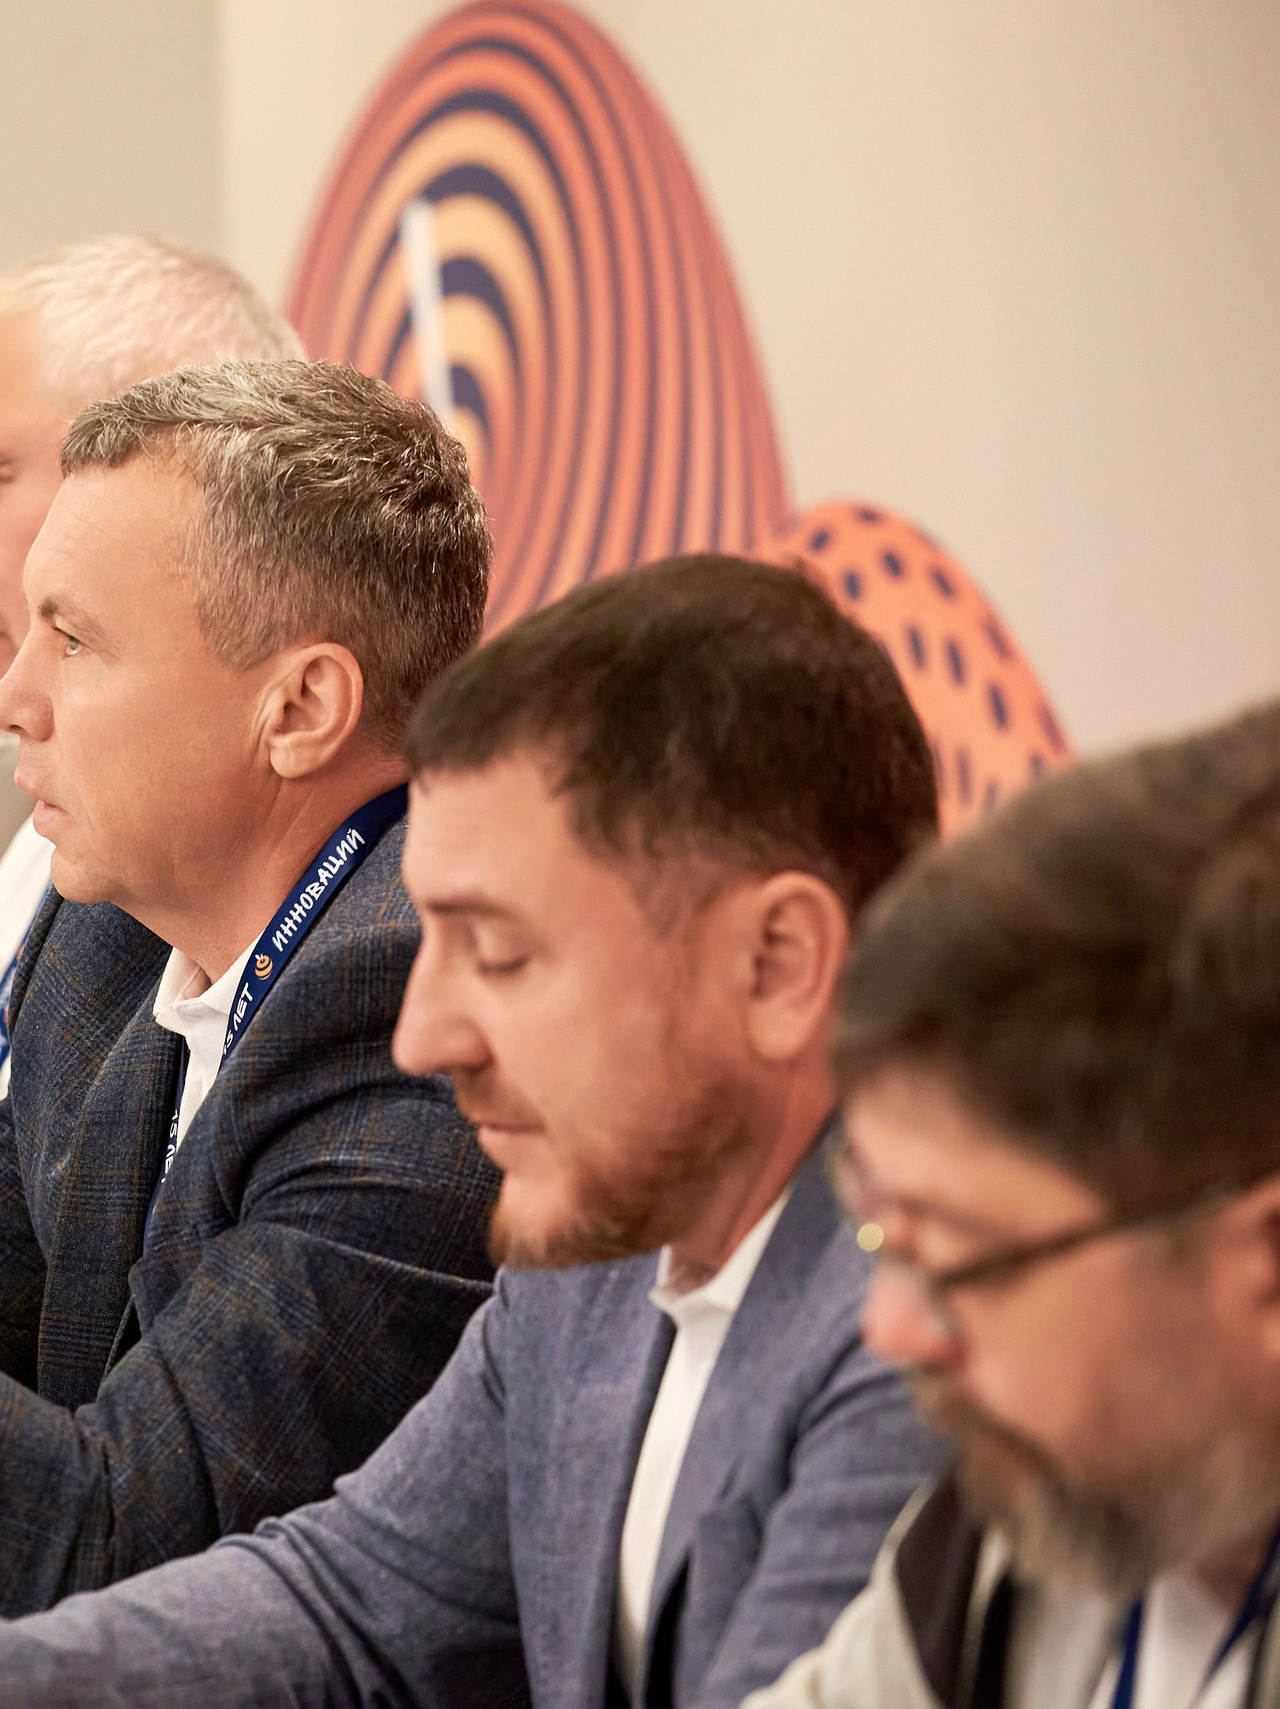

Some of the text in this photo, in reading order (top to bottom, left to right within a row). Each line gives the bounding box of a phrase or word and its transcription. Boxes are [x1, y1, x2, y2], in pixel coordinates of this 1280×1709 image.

[233, 981, 253, 1031] ЛЕТ
[271, 828, 365, 952] ИННОВАЦИЙ
[160, 1143, 176, 1184] ЛЕ
